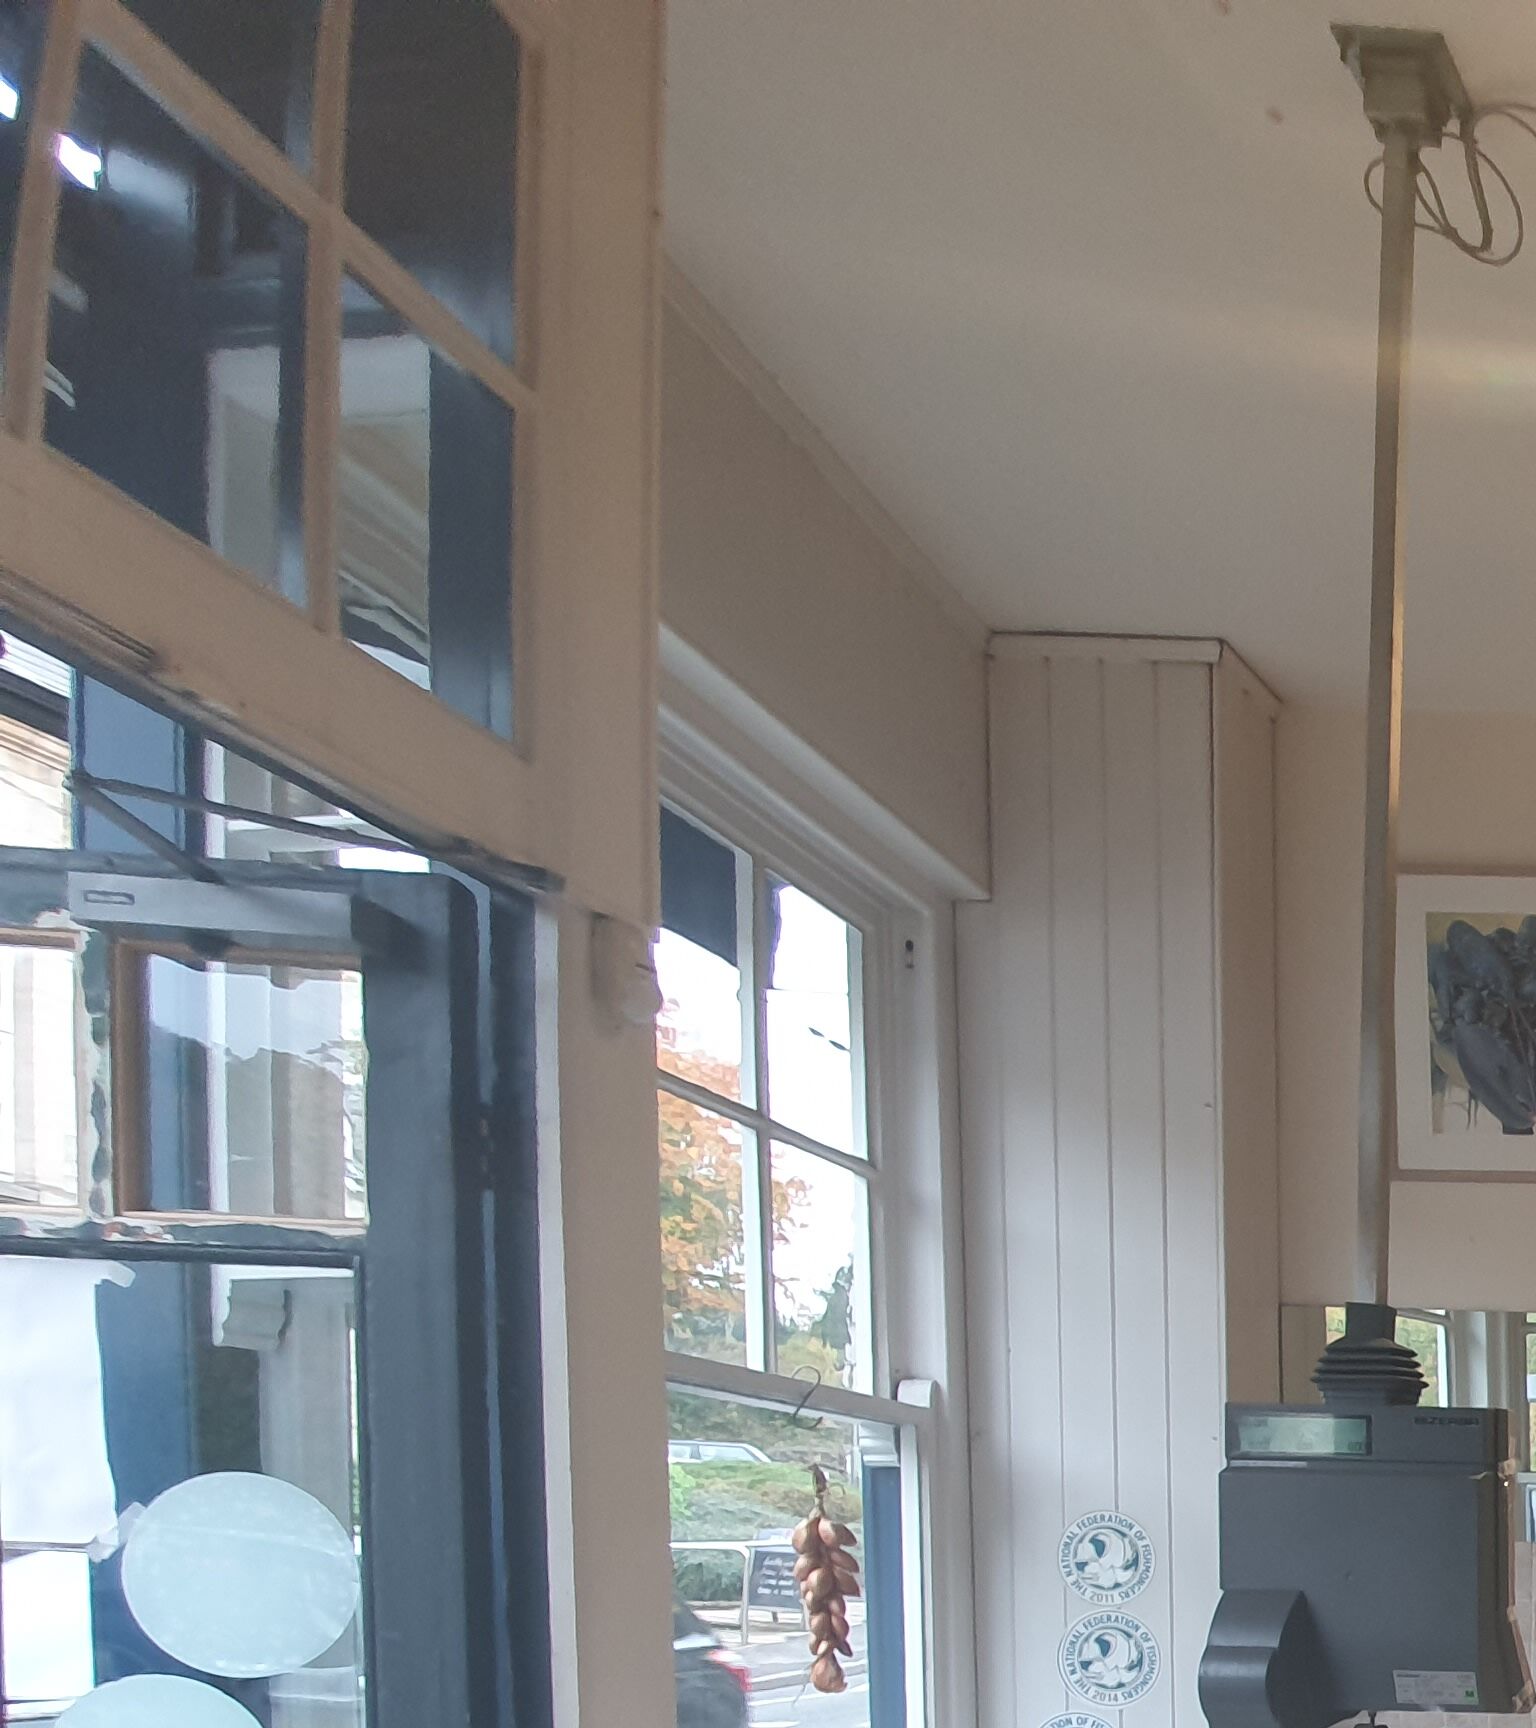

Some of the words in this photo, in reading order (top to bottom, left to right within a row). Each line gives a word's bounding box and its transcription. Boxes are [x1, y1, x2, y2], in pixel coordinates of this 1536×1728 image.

[1076, 1513, 1136, 1531] FEDERATION
[1133, 1530, 1147, 1542] OF
[1060, 1531, 1079, 1578] NATIONAL
[1118, 1543, 1153, 1601] FISHMONGERS
[1070, 1578, 1088, 1596] THE
[1089, 1591, 1115, 1603] 2011
[1082, 1613, 1142, 1633] FEDERATION
[1139, 1631, 1153, 1643] OF
[1065, 1629, 1085, 1676] NATIONAL
[1120, 1645, 1157, 1701] FISHMONGERS
[1073, 1677, 1092, 1696] THE
[1091, 1689, 1119, 1703] 2014
[1076, 1716, 1090, 1726] OF
